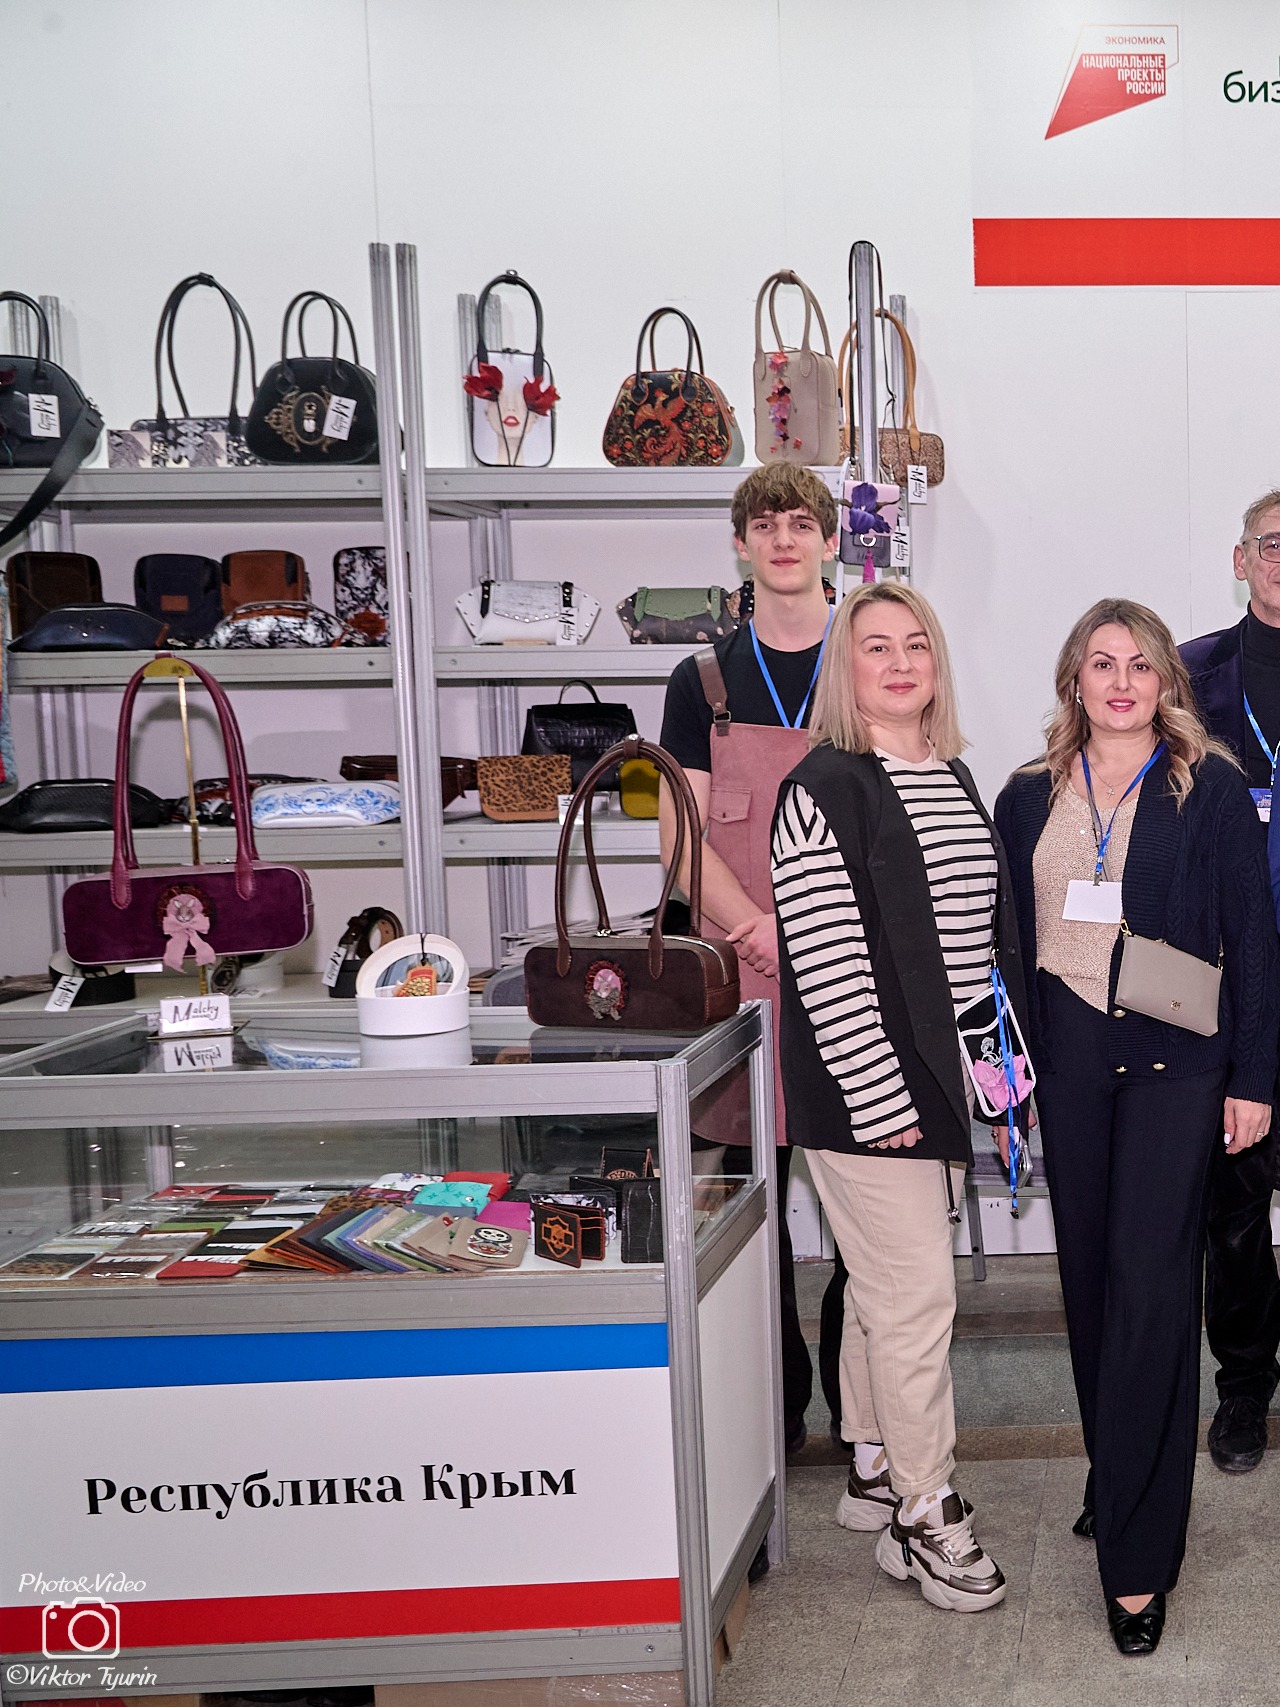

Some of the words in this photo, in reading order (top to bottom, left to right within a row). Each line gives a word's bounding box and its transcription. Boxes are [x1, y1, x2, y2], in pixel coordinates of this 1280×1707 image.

[1105, 36, 1166, 45] ЭКОНОМИКА
[1082, 55, 1165, 69] НАЦИОНАЛЬНЫЕ
[1117, 69, 1165, 81] ПРОЕКТЫ
[1126, 81, 1165, 94] РОССИИ
[172, 999, 219, 1024] Malchy
[83, 1469, 406, 1520] Республика
[420, 1463, 578, 1509] Крым
